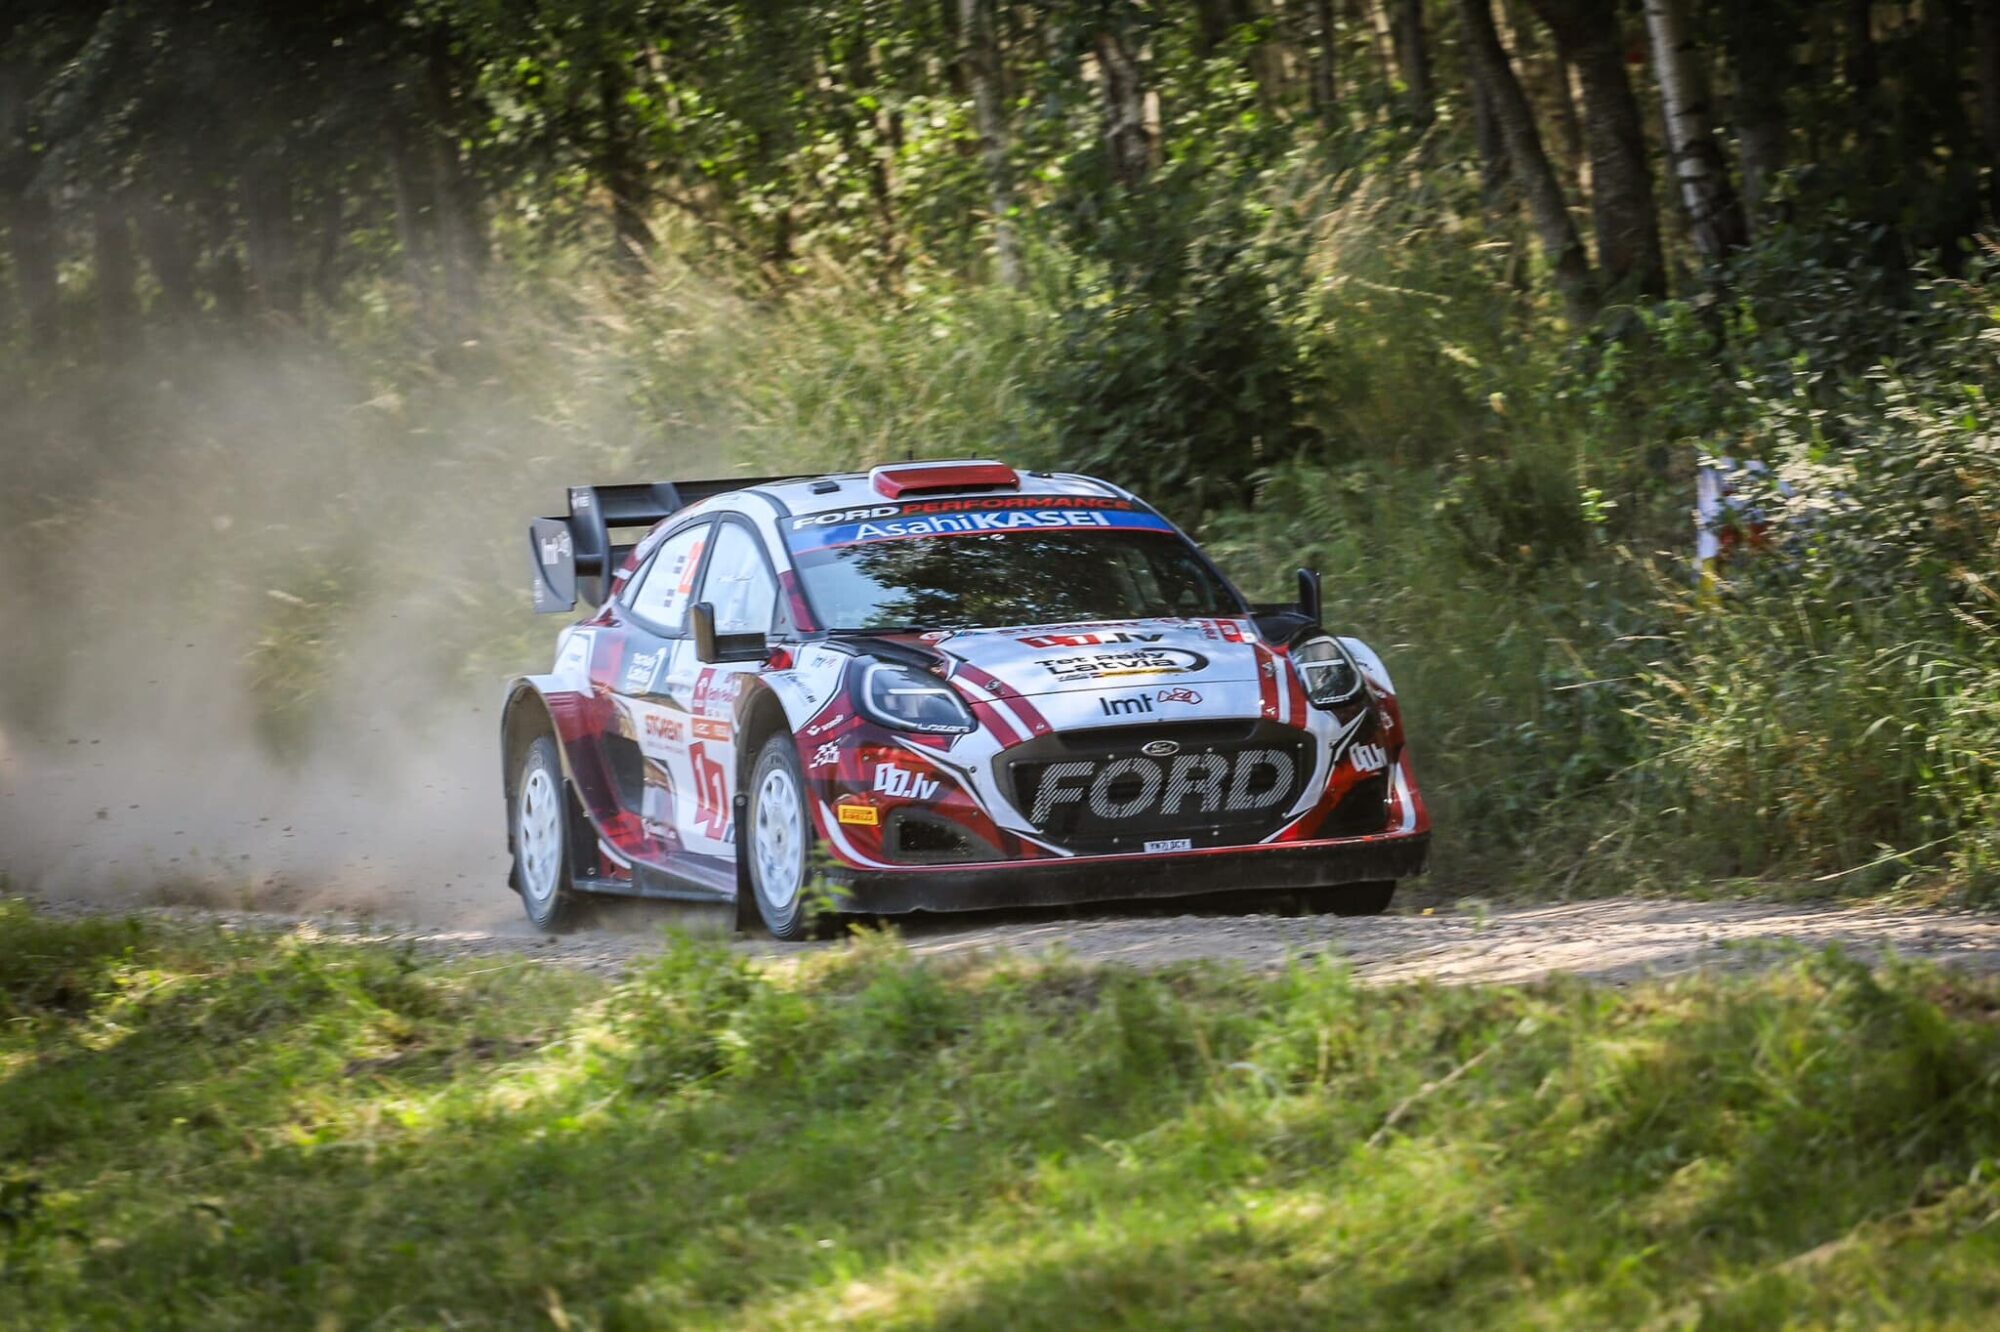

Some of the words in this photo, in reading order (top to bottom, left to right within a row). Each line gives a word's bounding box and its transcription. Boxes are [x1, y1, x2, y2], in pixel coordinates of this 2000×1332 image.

[792, 506, 900, 530] FORD
[902, 498, 1132, 515] PERFORMANCE
[856, 510, 1111, 541] AsahiKASEI
[1015, 631, 1163, 649] 11.lv
[1047, 658, 1178, 675] Latvia
[1094, 651, 1166, 662] Rally
[1099, 693, 1155, 716] lmt
[873, 762, 940, 800] 11.lv
[1029, 749, 1297, 824] FORD
